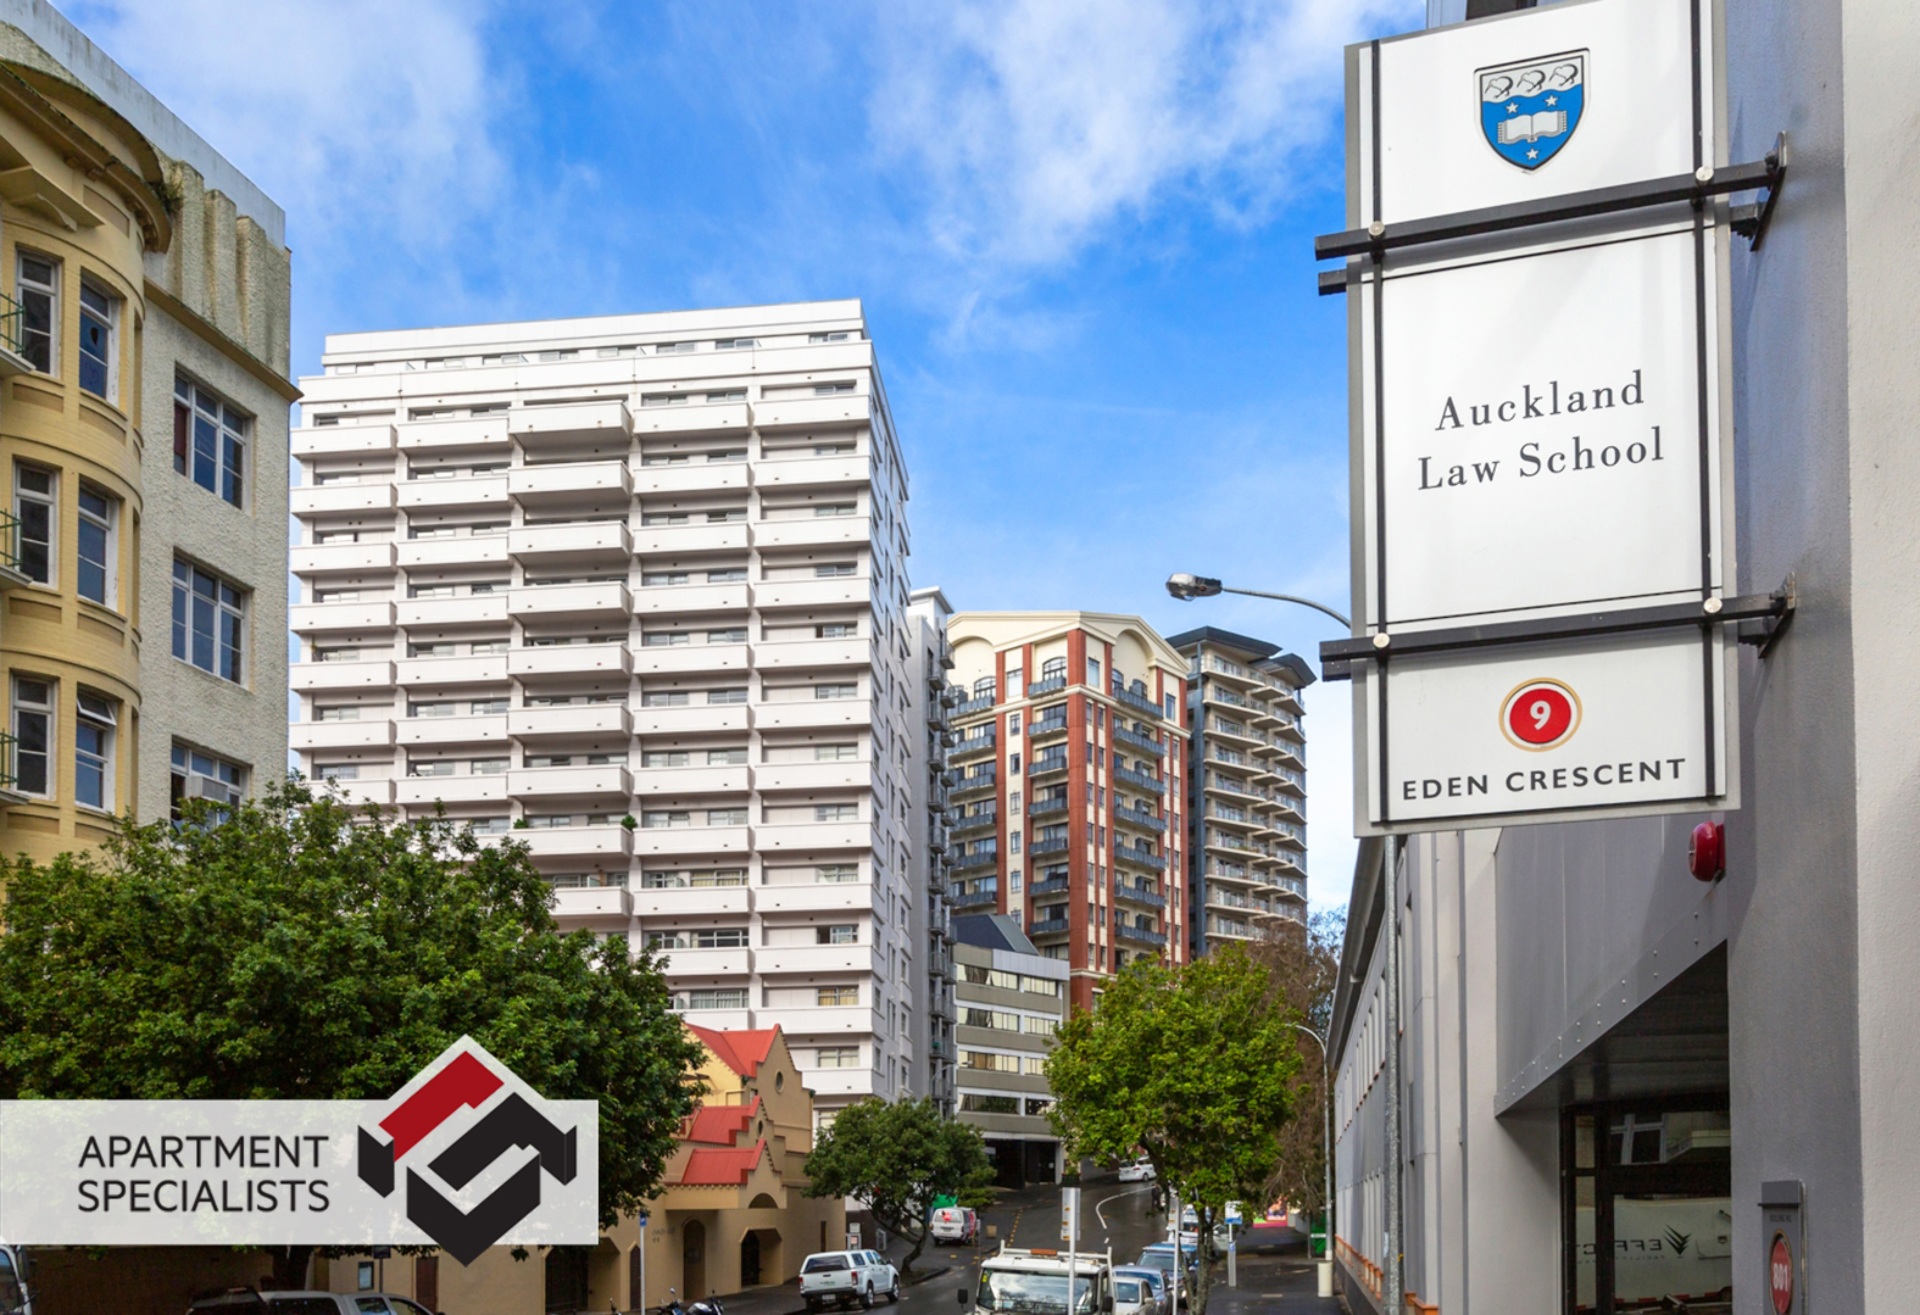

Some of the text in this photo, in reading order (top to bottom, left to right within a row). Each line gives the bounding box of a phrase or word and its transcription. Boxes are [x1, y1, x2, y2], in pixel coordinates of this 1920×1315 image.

[1435, 369, 1645, 431] Auckland
[1417, 426, 1664, 490] Law School
[1529, 700, 1551, 730] 9
[1402, 758, 1686, 800] EDEN CRESCENT
